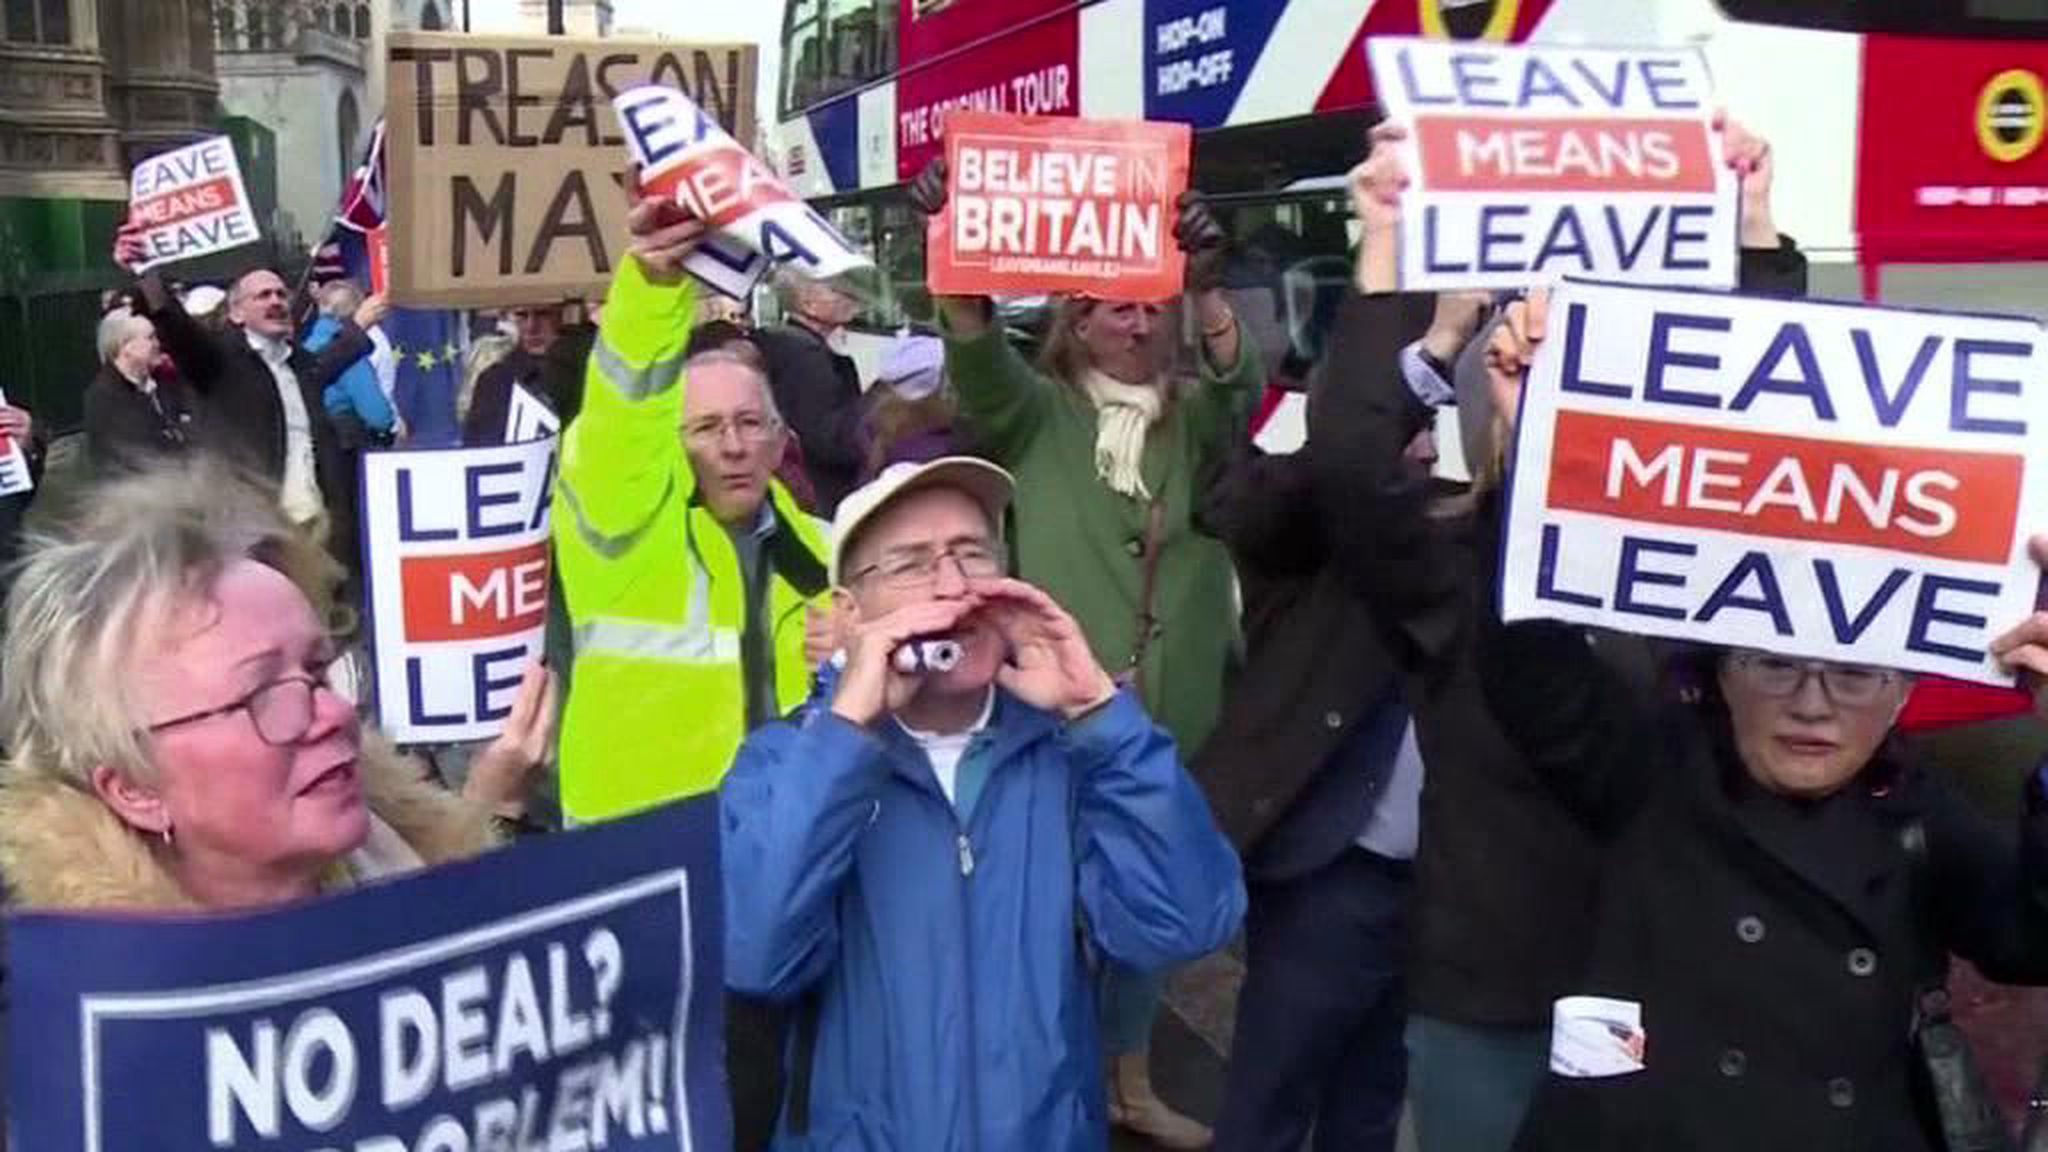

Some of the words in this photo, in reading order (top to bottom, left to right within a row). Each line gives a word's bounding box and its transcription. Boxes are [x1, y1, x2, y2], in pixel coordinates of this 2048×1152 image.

[1157, 6, 1226, 54] HOP-ON
[900, 105, 928, 147] THE
[1011, 63, 1070, 116] TOUR
[1157, 49, 1234, 95] HOP-OFF
[1397, 49, 1699, 109] LEAVE
[958, 147, 1116, 197] BELIEVE
[1125, 158, 1164, 197] IN
[1455, 129, 1681, 178] MEANS
[451, 169, 632, 278] MA
[955, 196, 1160, 258] BRITAIN
[1424, 205, 1714, 272] LEAVE
[1560, 303, 2034, 435] LEAVE
[1606, 438, 1960, 537] MEANS
[1536, 524, 2003, 664] LEAVE
[206, 1006, 358, 1147] NO
[379, 928, 624, 1113] DEAL?
